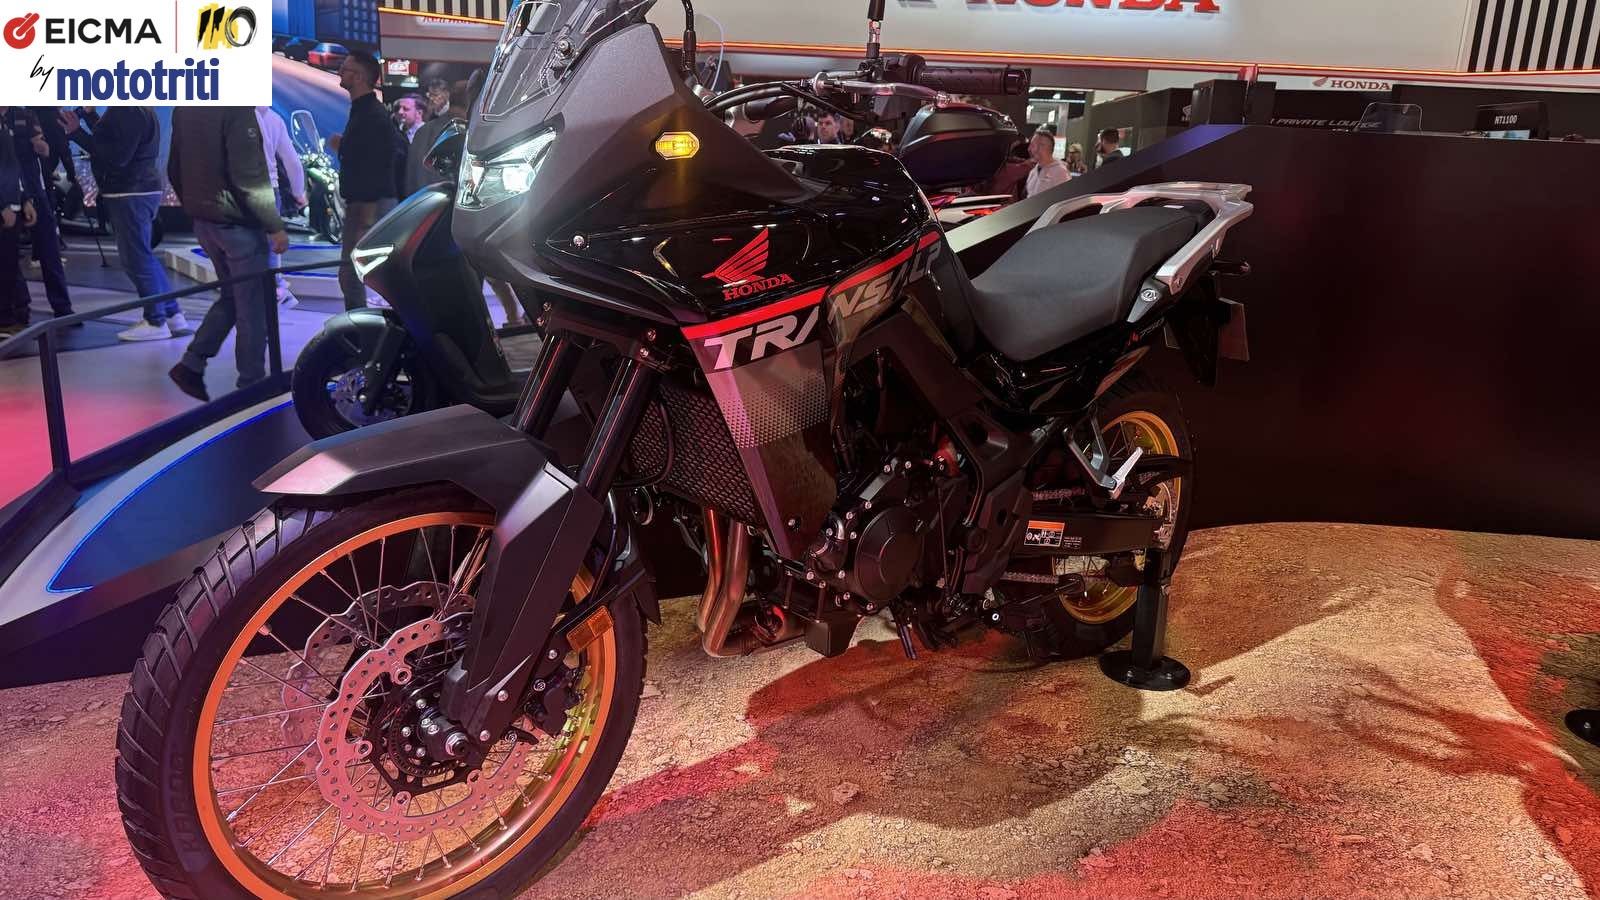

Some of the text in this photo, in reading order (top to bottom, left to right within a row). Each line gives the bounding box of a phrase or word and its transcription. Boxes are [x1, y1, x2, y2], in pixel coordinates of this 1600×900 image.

[1330, 79, 1391, 90] HONDA
[1494, 115, 1518, 125] NT1100
[722, 273, 795, 301] HONDA
